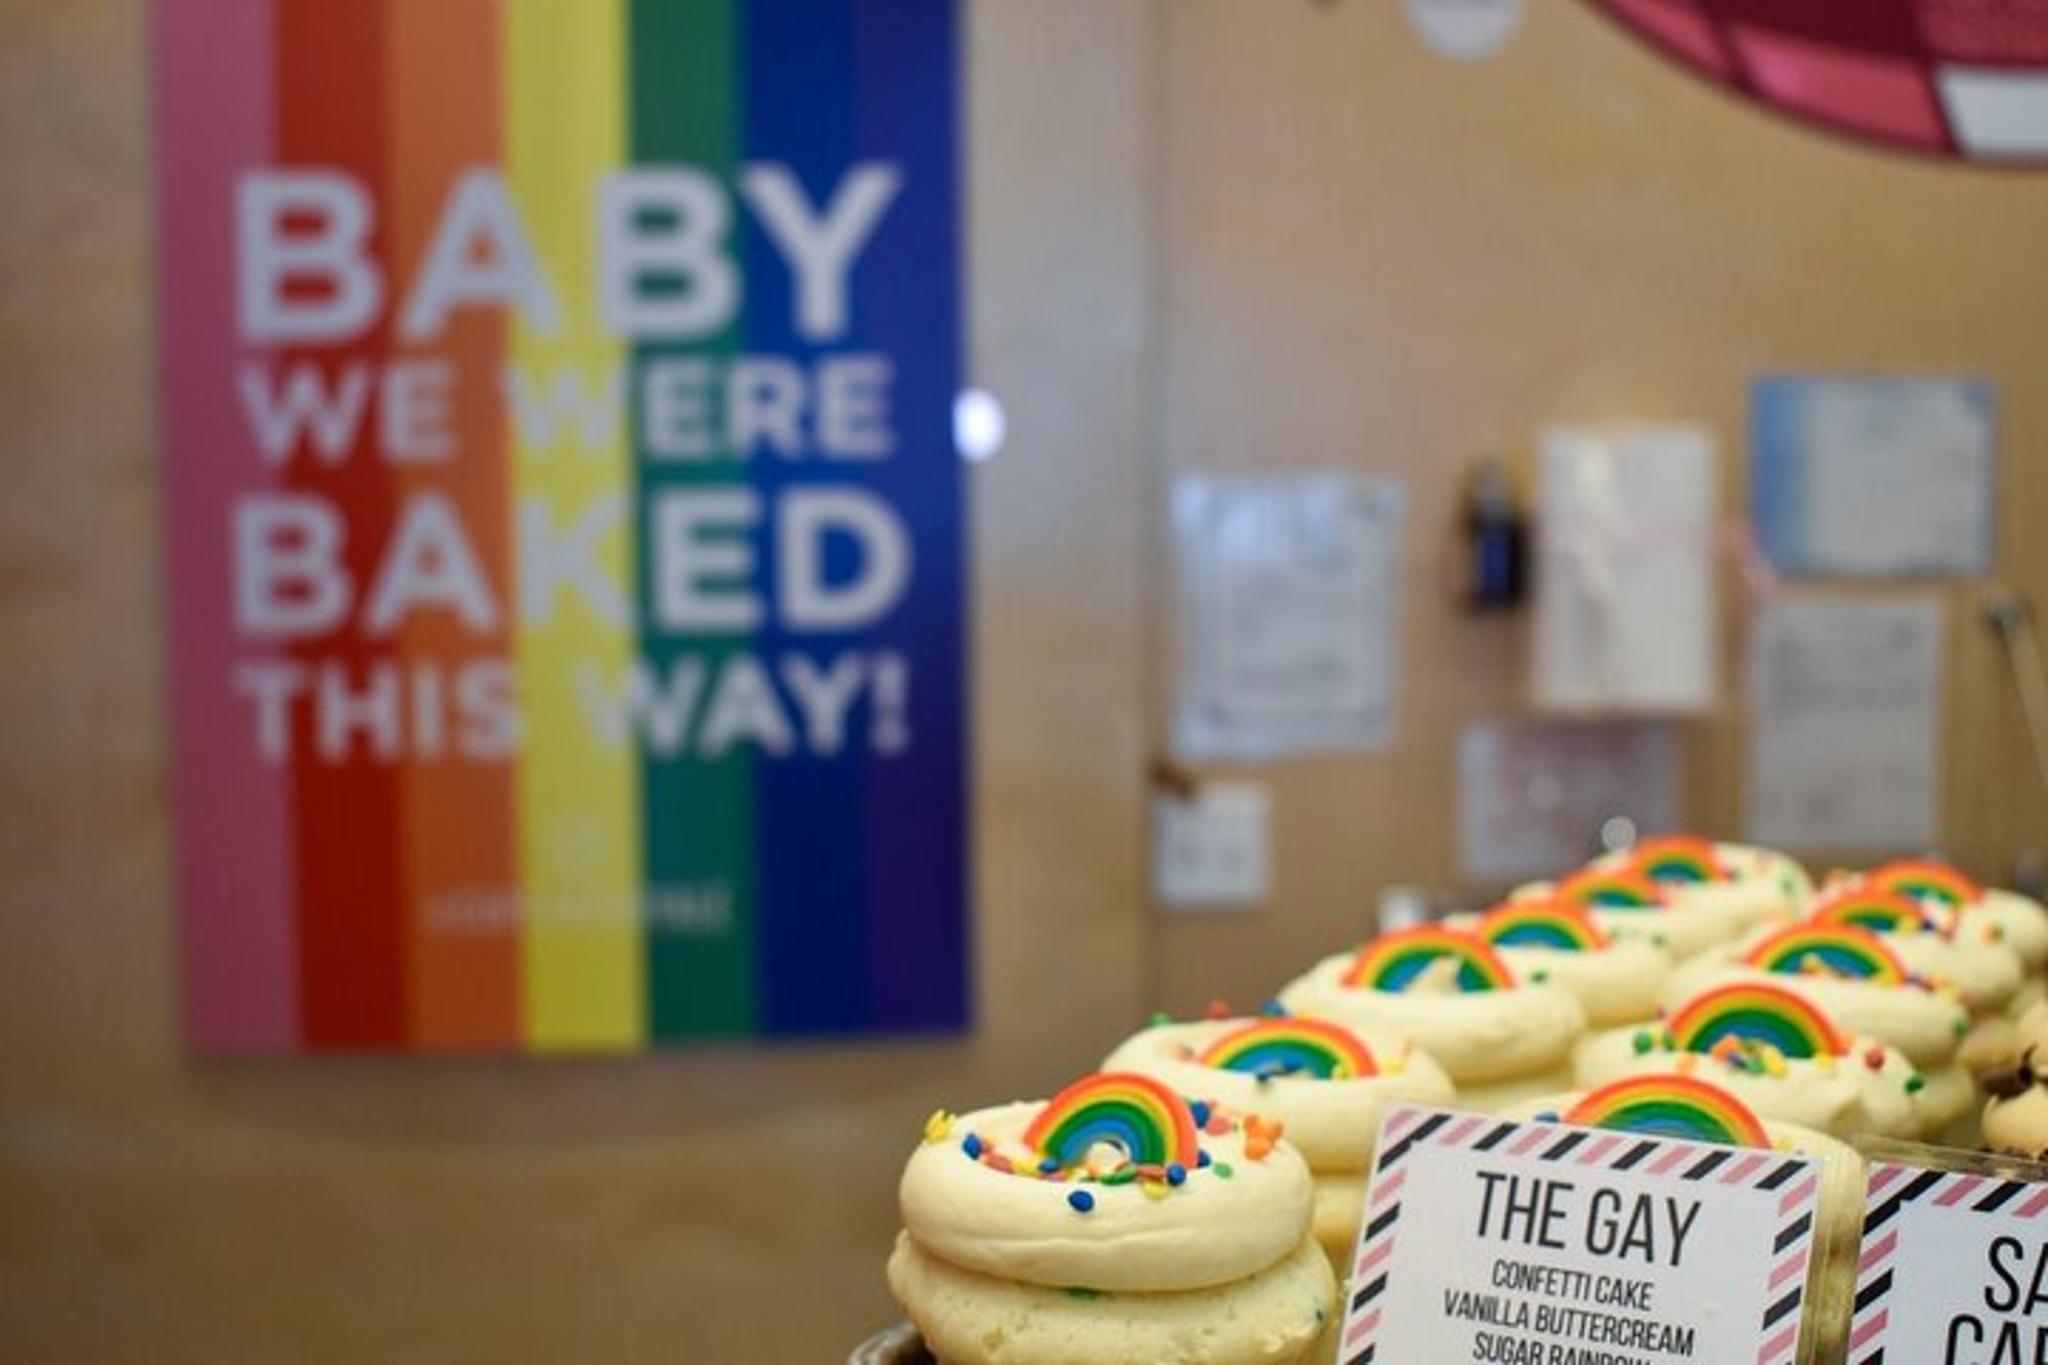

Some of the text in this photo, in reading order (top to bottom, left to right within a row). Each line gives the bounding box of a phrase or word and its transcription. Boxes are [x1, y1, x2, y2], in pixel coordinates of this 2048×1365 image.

[234, 166, 903, 341] BABY
[236, 356, 894, 464] WE WERE
[232, 485, 912, 638] BAKED
[231, 652, 908, 763] THIS WAY!
[1476, 1170, 1702, 1267] THE GAY
[1443, 1287, 1695, 1357] VANILLA BUTTERCREAM
[1491, 1259, 1655, 1312] CONFETTI CAKE
[1472, 1331, 1655, 1365] SUGAR RAIN
[1945, 1314, 2048, 1365] CA
